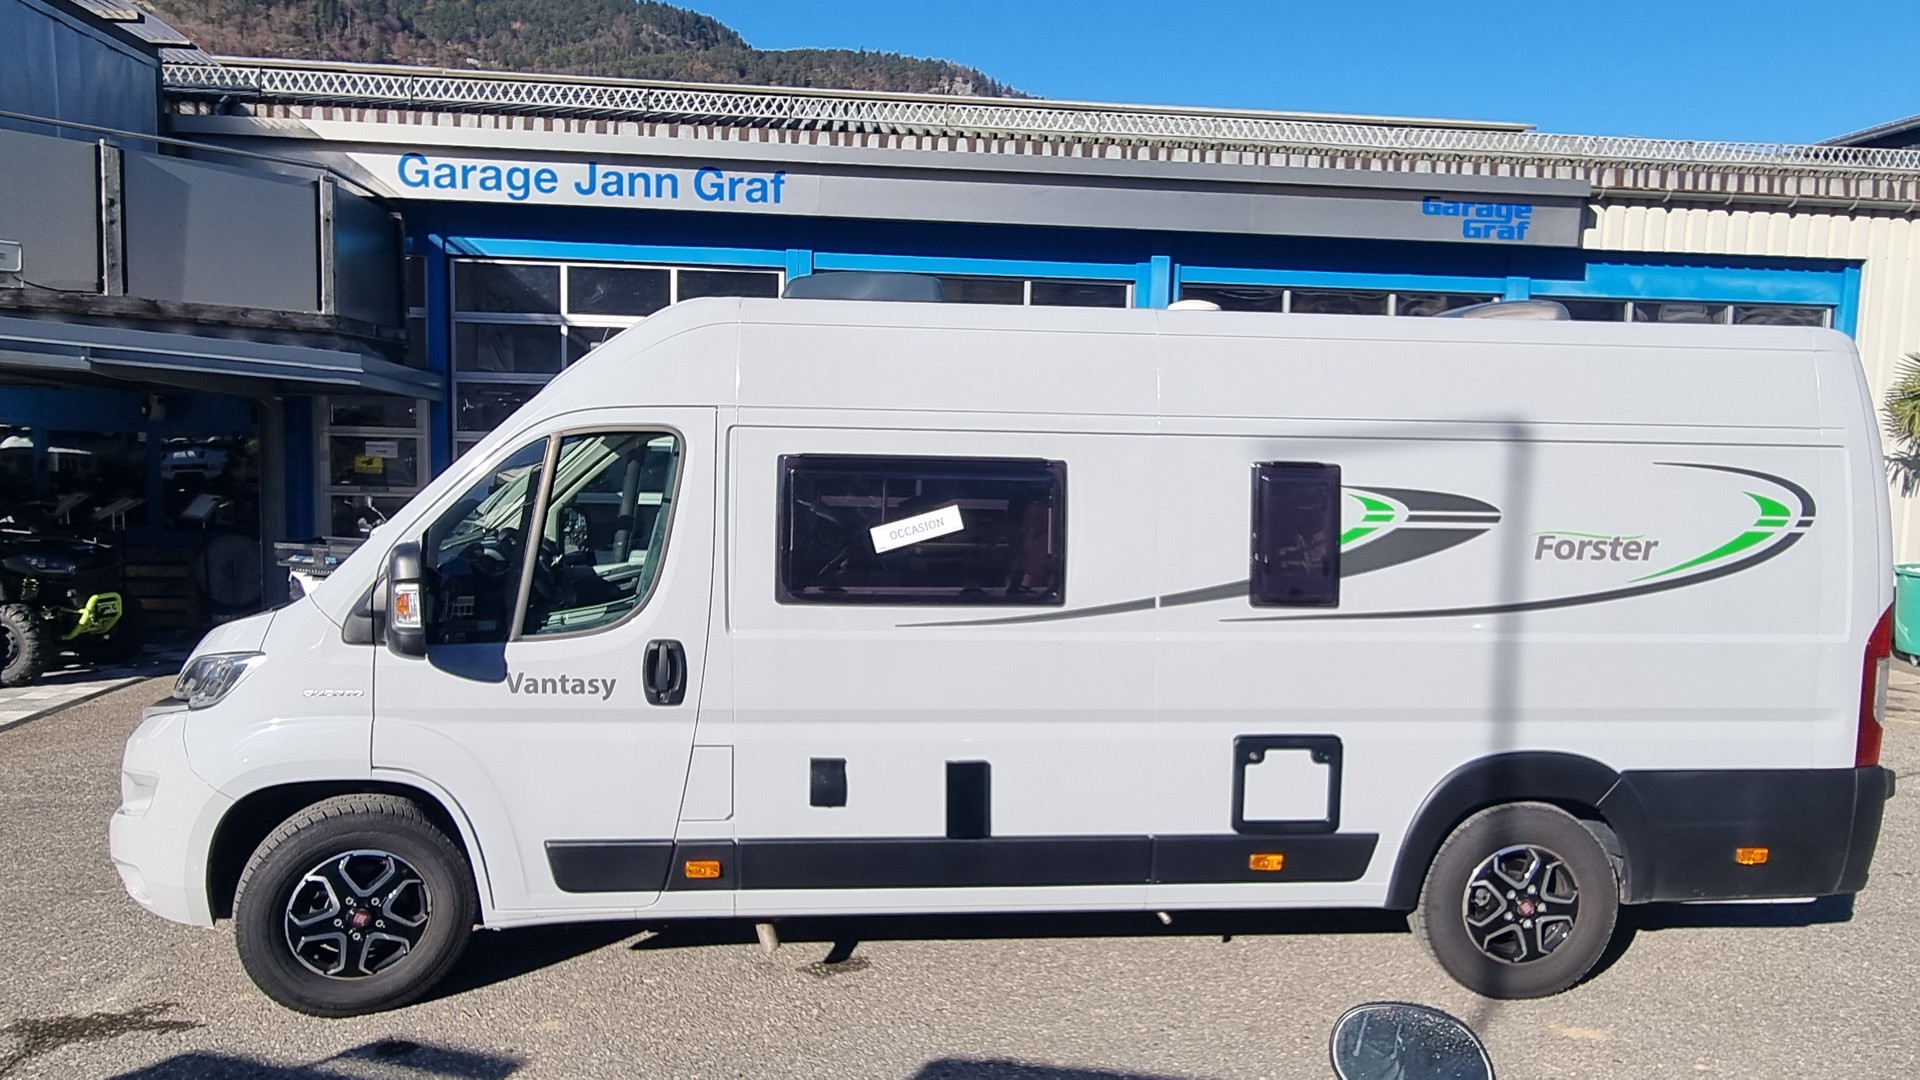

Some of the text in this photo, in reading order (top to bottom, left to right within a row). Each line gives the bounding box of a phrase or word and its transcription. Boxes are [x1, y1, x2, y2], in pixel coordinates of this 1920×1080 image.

[398, 152, 786, 204] Garage Jann Graf
[1422, 195, 1533, 224] Garage
[1462, 218, 1531, 241] Graf
[889, 517, 945, 541] OCCASION
[1534, 535, 1660, 562] Forster
[506, 671, 617, 702] Vantasy
